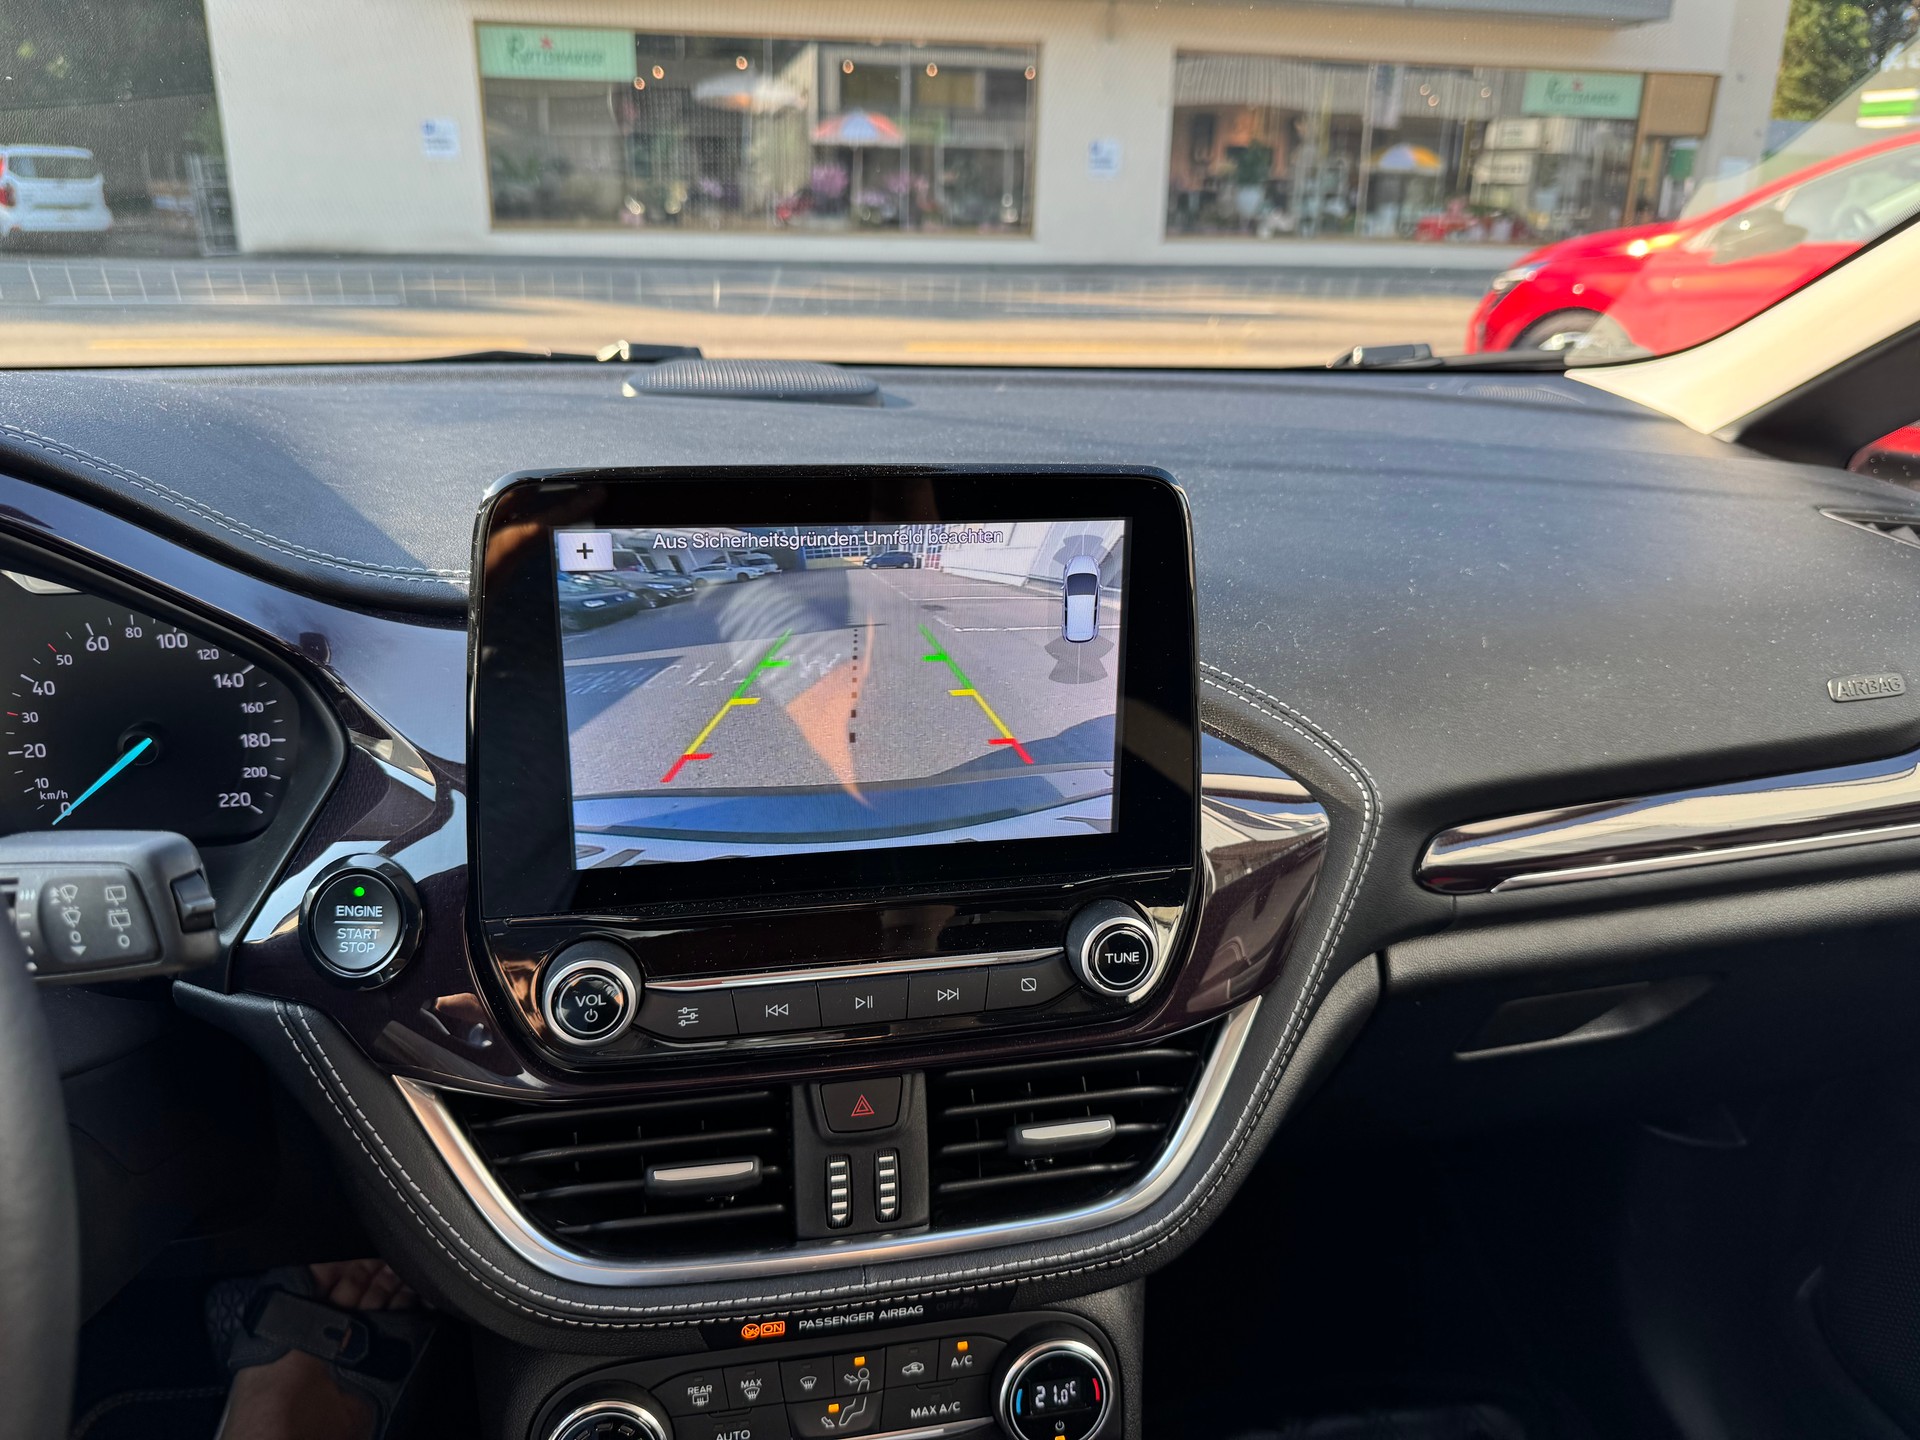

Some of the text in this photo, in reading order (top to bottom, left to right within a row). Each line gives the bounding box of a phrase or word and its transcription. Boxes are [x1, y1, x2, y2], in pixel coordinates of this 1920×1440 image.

[653, 527, 1004, 550] Aus Sicherheitsgründen Umfeld beachten
[125, 626, 143, 639] 80
[86, 635, 110, 652] 60
[156, 632, 189, 649] 100
[56, 654, 73, 666] 50
[197, 648, 220, 661] 120
[213, 672, 245, 689] 140
[32, 680, 56, 696] 40
[1837, 677, 1901, 698] AIRBAG
[241, 702, 264, 714] 160
[21, 711, 39, 723] 30
[240, 732, 271, 748] 180
[23, 743, 47, 759] 20
[242, 766, 268, 779] 200
[34, 777, 50, 789] 10
[39, 790, 69, 800] km/h
[218, 791, 251, 808] 220
[60, 801, 72, 816] 0
[335, 905, 383, 917] ENGINE
[337, 928, 381, 940] START
[338, 941, 376, 953] STOP
[1104, 951, 1140, 964] TUNE
[575, 994, 607, 1008] VOL
[799, 1304, 924, 1330] PASSENGER AIRBAG
[762, 1323, 784, 1335] ON
[950, 1354, 973, 1368] A/C
[740, 1377, 762, 1389] MAX
[687, 1384, 713, 1396] REAR
[910, 1401, 961, 1419] MAX A/C
[716, 1429, 751, 1440] AUTO
